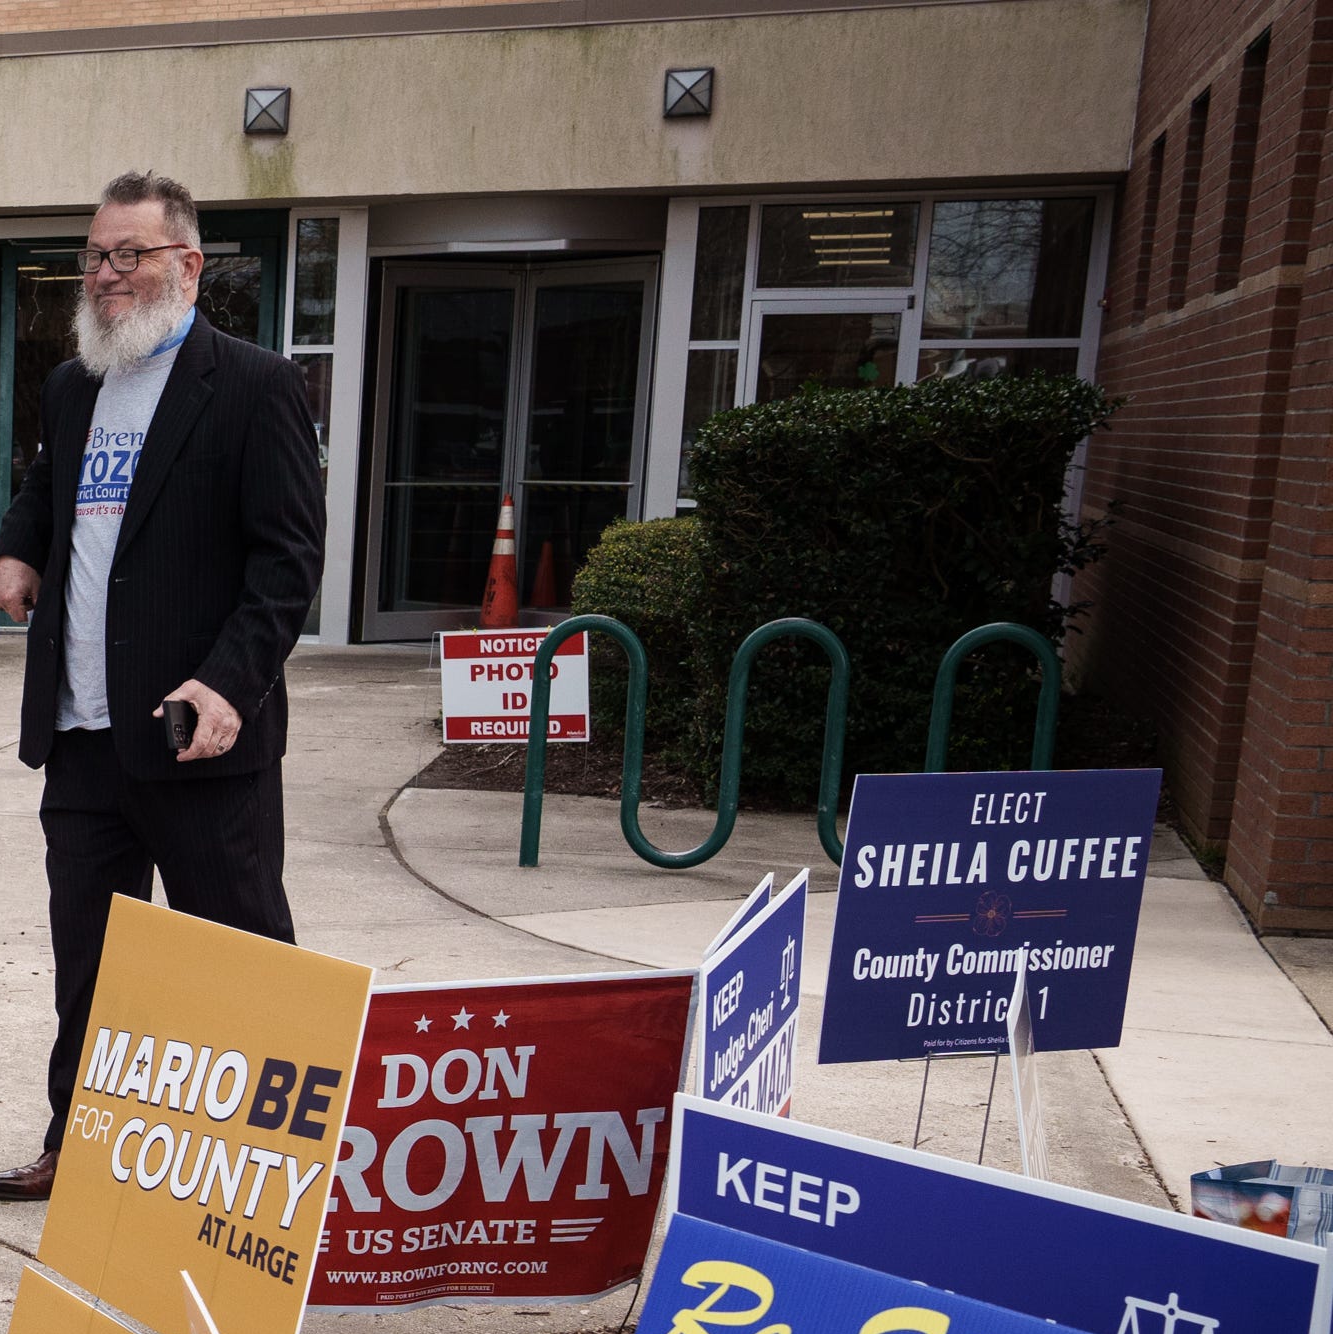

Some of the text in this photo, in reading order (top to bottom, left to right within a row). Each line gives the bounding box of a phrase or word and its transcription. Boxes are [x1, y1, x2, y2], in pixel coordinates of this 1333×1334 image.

[95, 485, 128, 499] Court
[502, 692, 528, 710] ID
[470, 720, 561, 736] REQUID
[970, 792, 1047, 825] ELECT
[854, 836, 1142, 888] SHEILA CUFFEE
[853, 947, 939, 982] County
[712, 970, 744, 1032] KEEP
[907, 986, 1049, 1027] Distric 1
[710, 991, 774, 1092] Judge Cheri
[82, 1027, 342, 1141] MARIO BE
[377, 1045, 535, 1108] DON
[69, 1104, 326, 1230] FOR COUNTY
[716, 1152, 861, 1227] KEEP
[197, 1213, 226, 1251] AT
[226, 1224, 299, 1286] LARGE
[346, 1229, 394, 1254] US
[401, 1219, 537, 1254] SENATE
[326, 1261, 548, 1284] WWW.BROWNFORNC.COM
